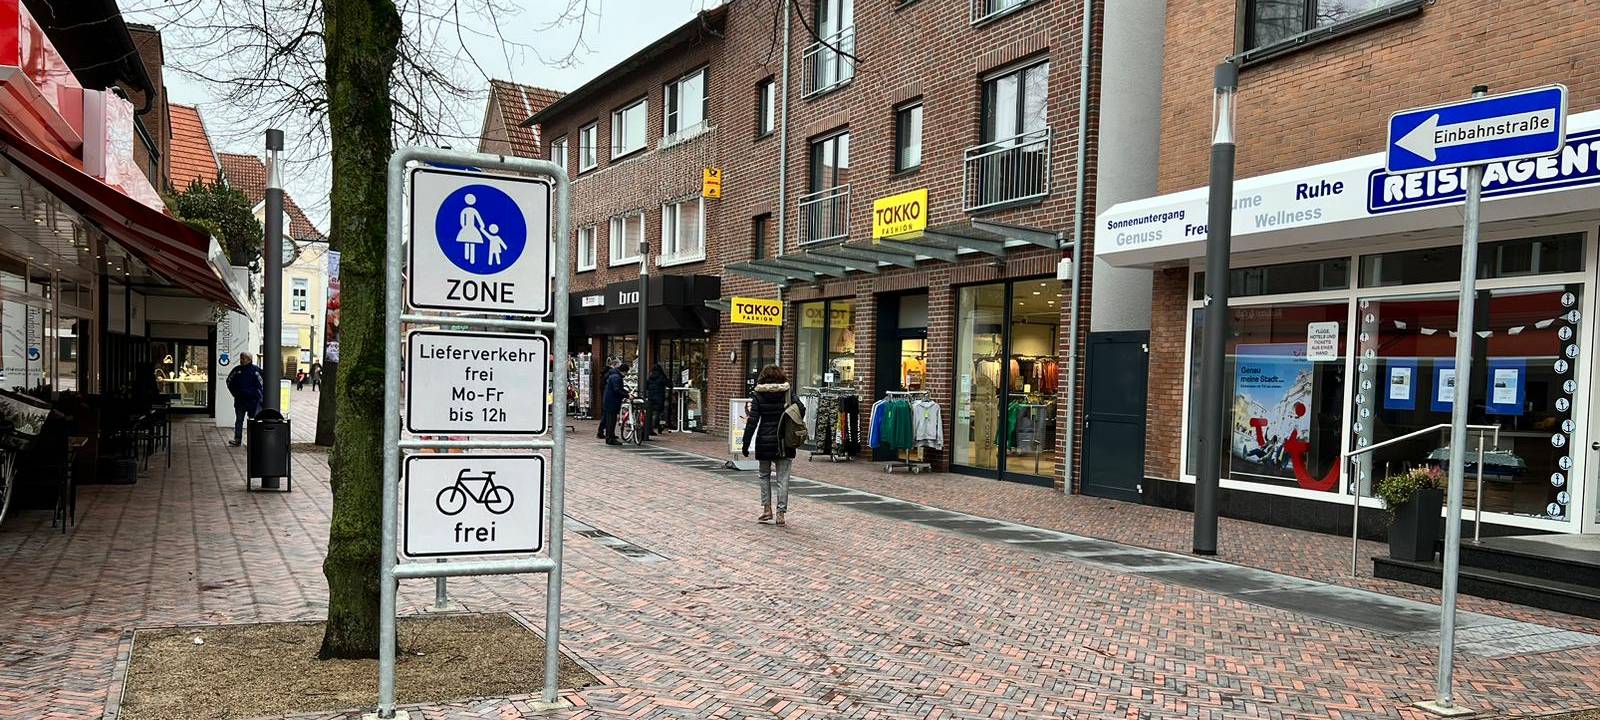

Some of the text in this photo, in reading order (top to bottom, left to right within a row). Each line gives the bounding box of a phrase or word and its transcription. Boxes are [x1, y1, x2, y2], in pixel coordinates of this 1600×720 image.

[1434, 116, 1549, 144] Einbahnstraße
[1296, 180, 1344, 201] Ruhe
[1107, 209, 1186, 231] Sonnenuntergang
[1255, 208, 1323, 229] Wellness
[882, 223, 913, 235] FASHION
[1116, 230, 1164, 247] Genuss
[446, 279, 515, 304] ZONE
[619, 292, 640, 305] bro
[420, 343, 537, 363] Lieferverkehr
[465, 366, 493, 382] frei
[1240, 366, 1261, 374] Genau
[451, 387, 505, 403] Mo-Fr
[449, 407, 507, 423] bis 12h
[454, 521, 497, 544] frei
